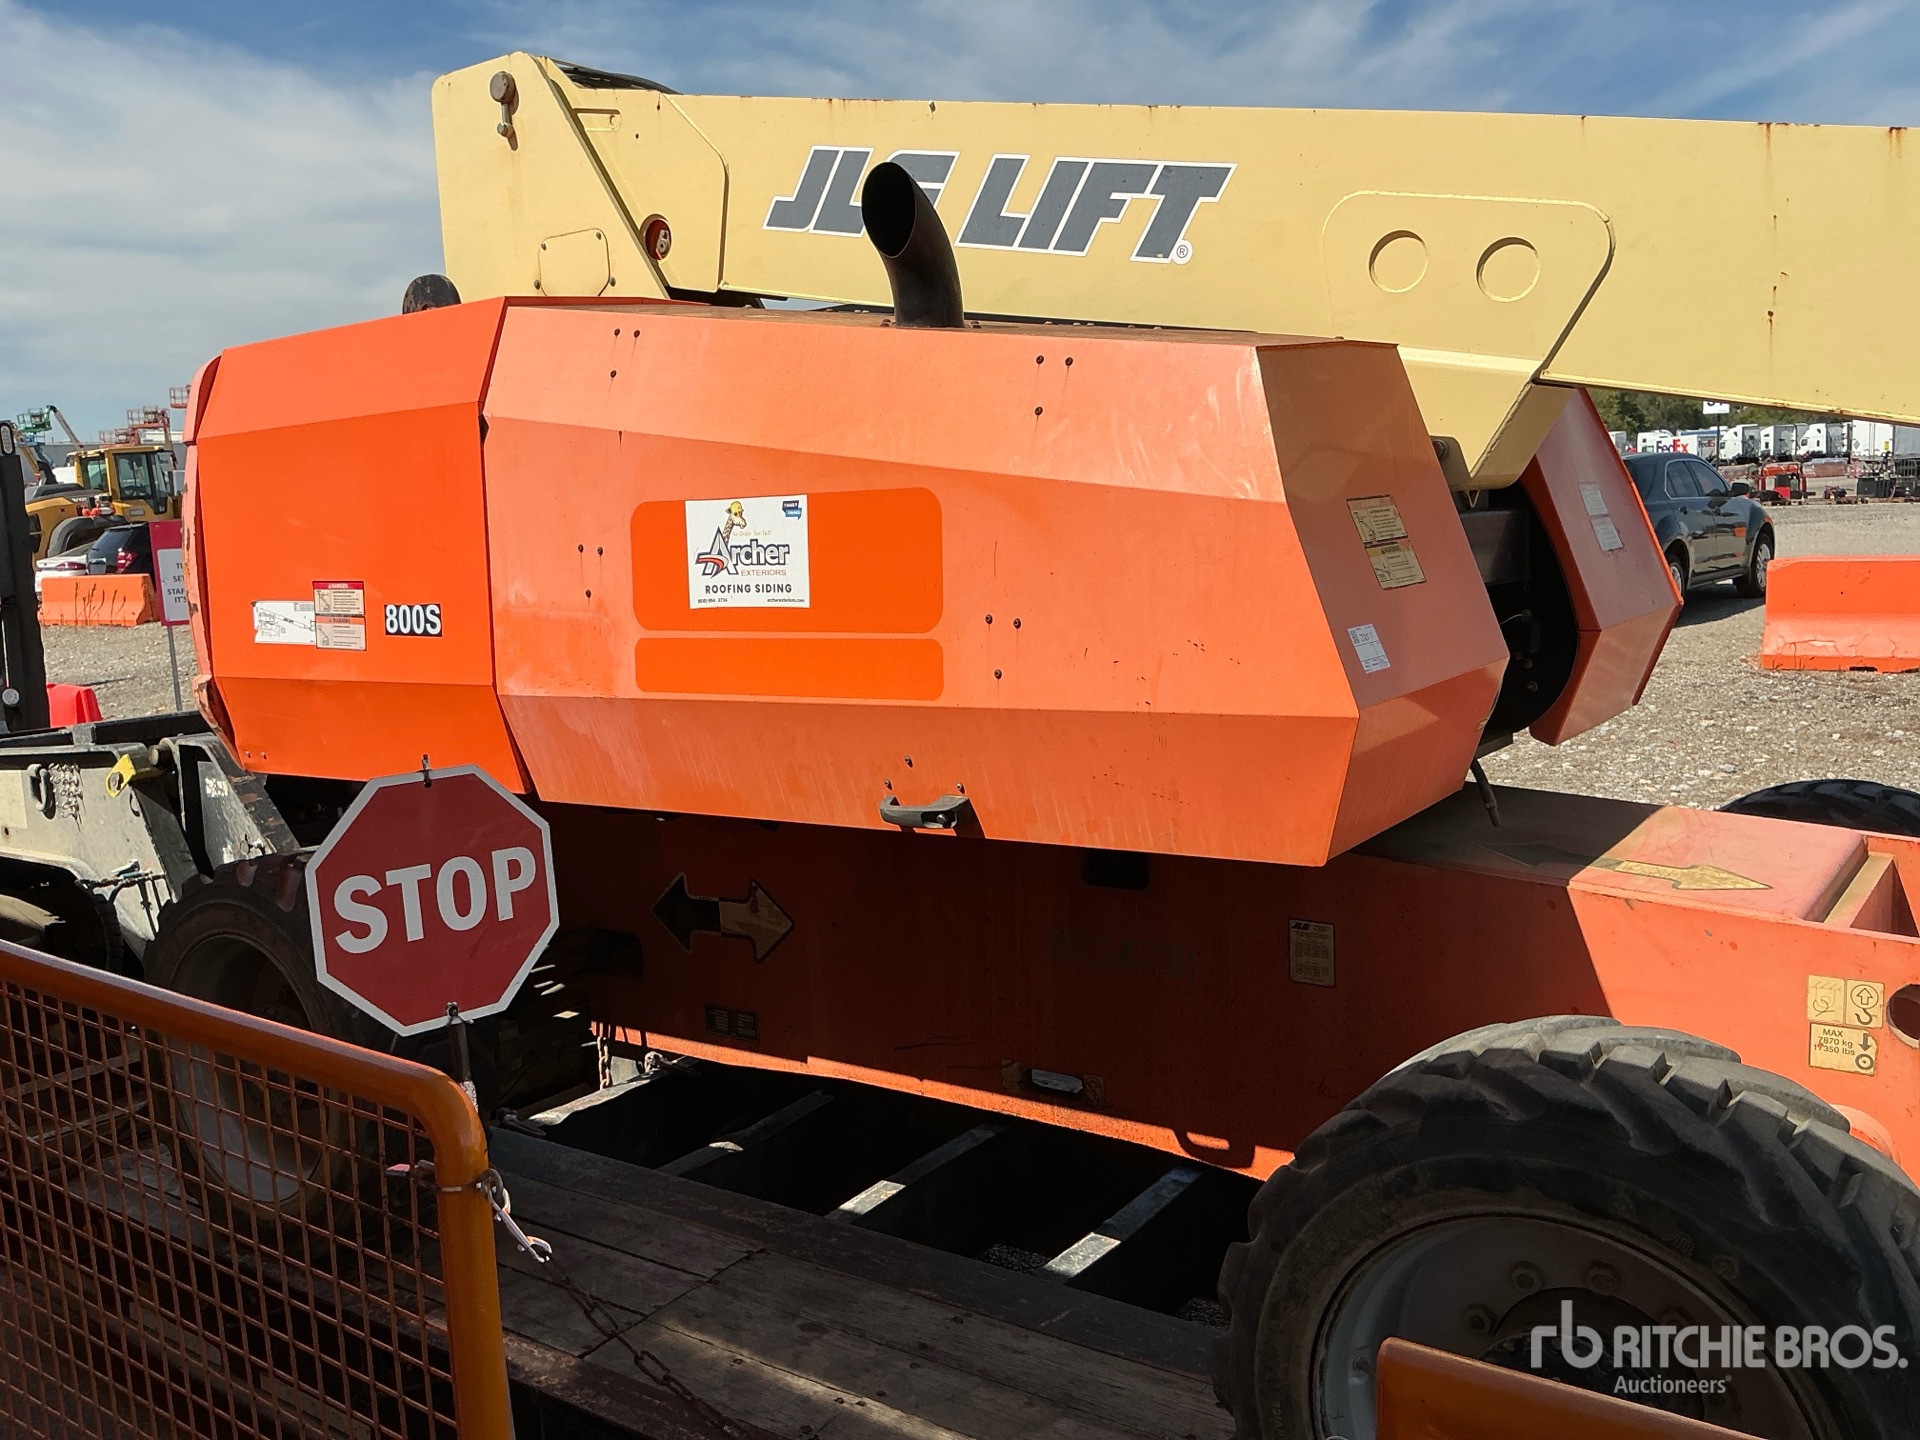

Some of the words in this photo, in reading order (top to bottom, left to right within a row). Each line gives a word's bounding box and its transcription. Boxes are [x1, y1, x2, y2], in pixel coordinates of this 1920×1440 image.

[954, 154, 1239, 264] LIFT
[1656, 439, 1689, 453] FedEx
[694, 526, 790, 578] Archer
[741, 569, 787, 577] EXTERIORS
[705, 584, 752, 595] ROOFING
[755, 583, 793, 594] SIDING
[386, 604, 441, 635] 800S
[334, 846, 536, 954] STOP
[1823, 1029, 1843, 1037] MAX
[1818, 1037, 1839, 1045] 7870
[1842, 1039, 1853, 1049] kg
[1842, 1046, 1856, 1056] lbs
